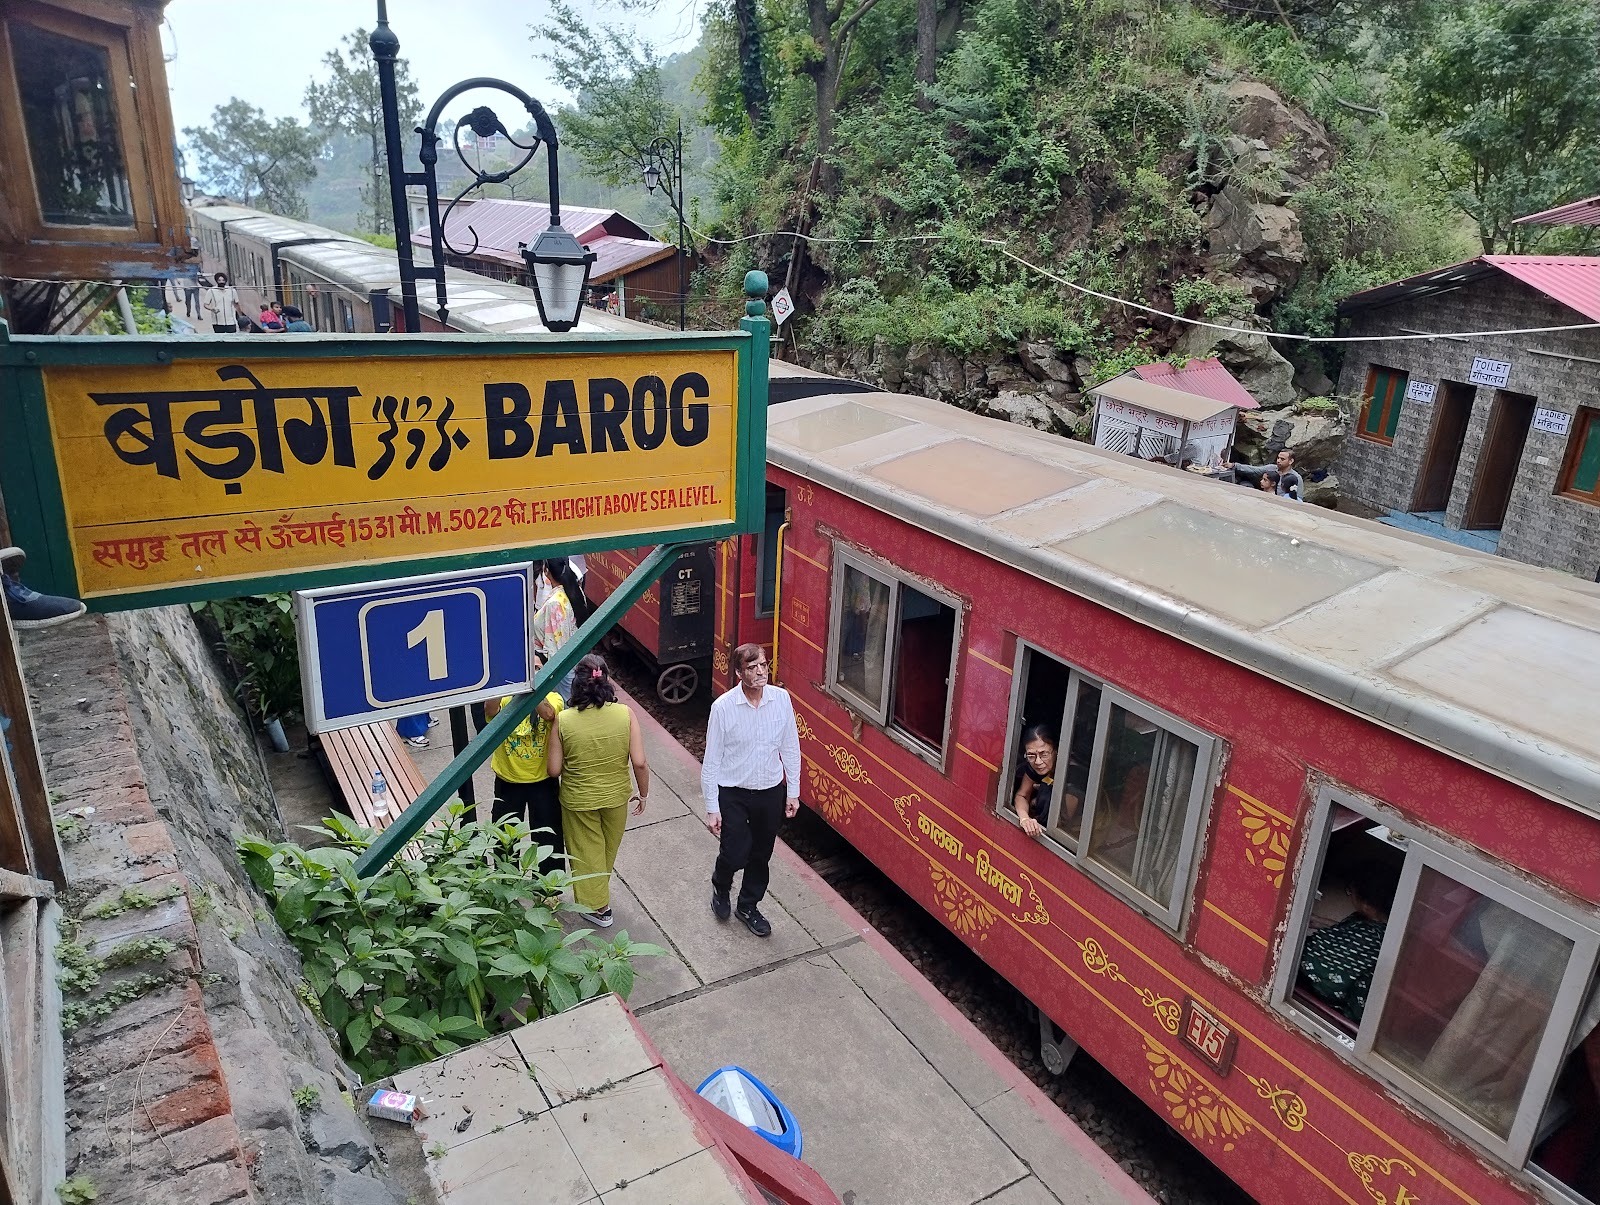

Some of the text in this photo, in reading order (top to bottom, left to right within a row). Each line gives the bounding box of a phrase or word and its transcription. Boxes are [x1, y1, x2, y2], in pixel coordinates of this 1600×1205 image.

[1475, 359, 1509, 373] TOILET
[1412, 382, 1433, 392] GENTS
[1540, 410, 1567, 421] LADIES
[86, 364, 363, 497] बड़ोग
[483, 372, 711, 460] BAROG
[1537, 418, 1566, 431] महिला
[93, 535, 171, 570] समुद्र
[176, 529, 230, 558] तल
[234, 519, 263, 554] से
[266, 511, 347, 549] ऊँचाई
[603, 491, 648, 516] ABOVE
[650, 488, 678, 511] SEA
[678, 568, 693, 580] CT
[407, 609, 449, 681] 1
[917, 810, 964, 862] कालका
[975, 848, 1023, 908] शिमला
